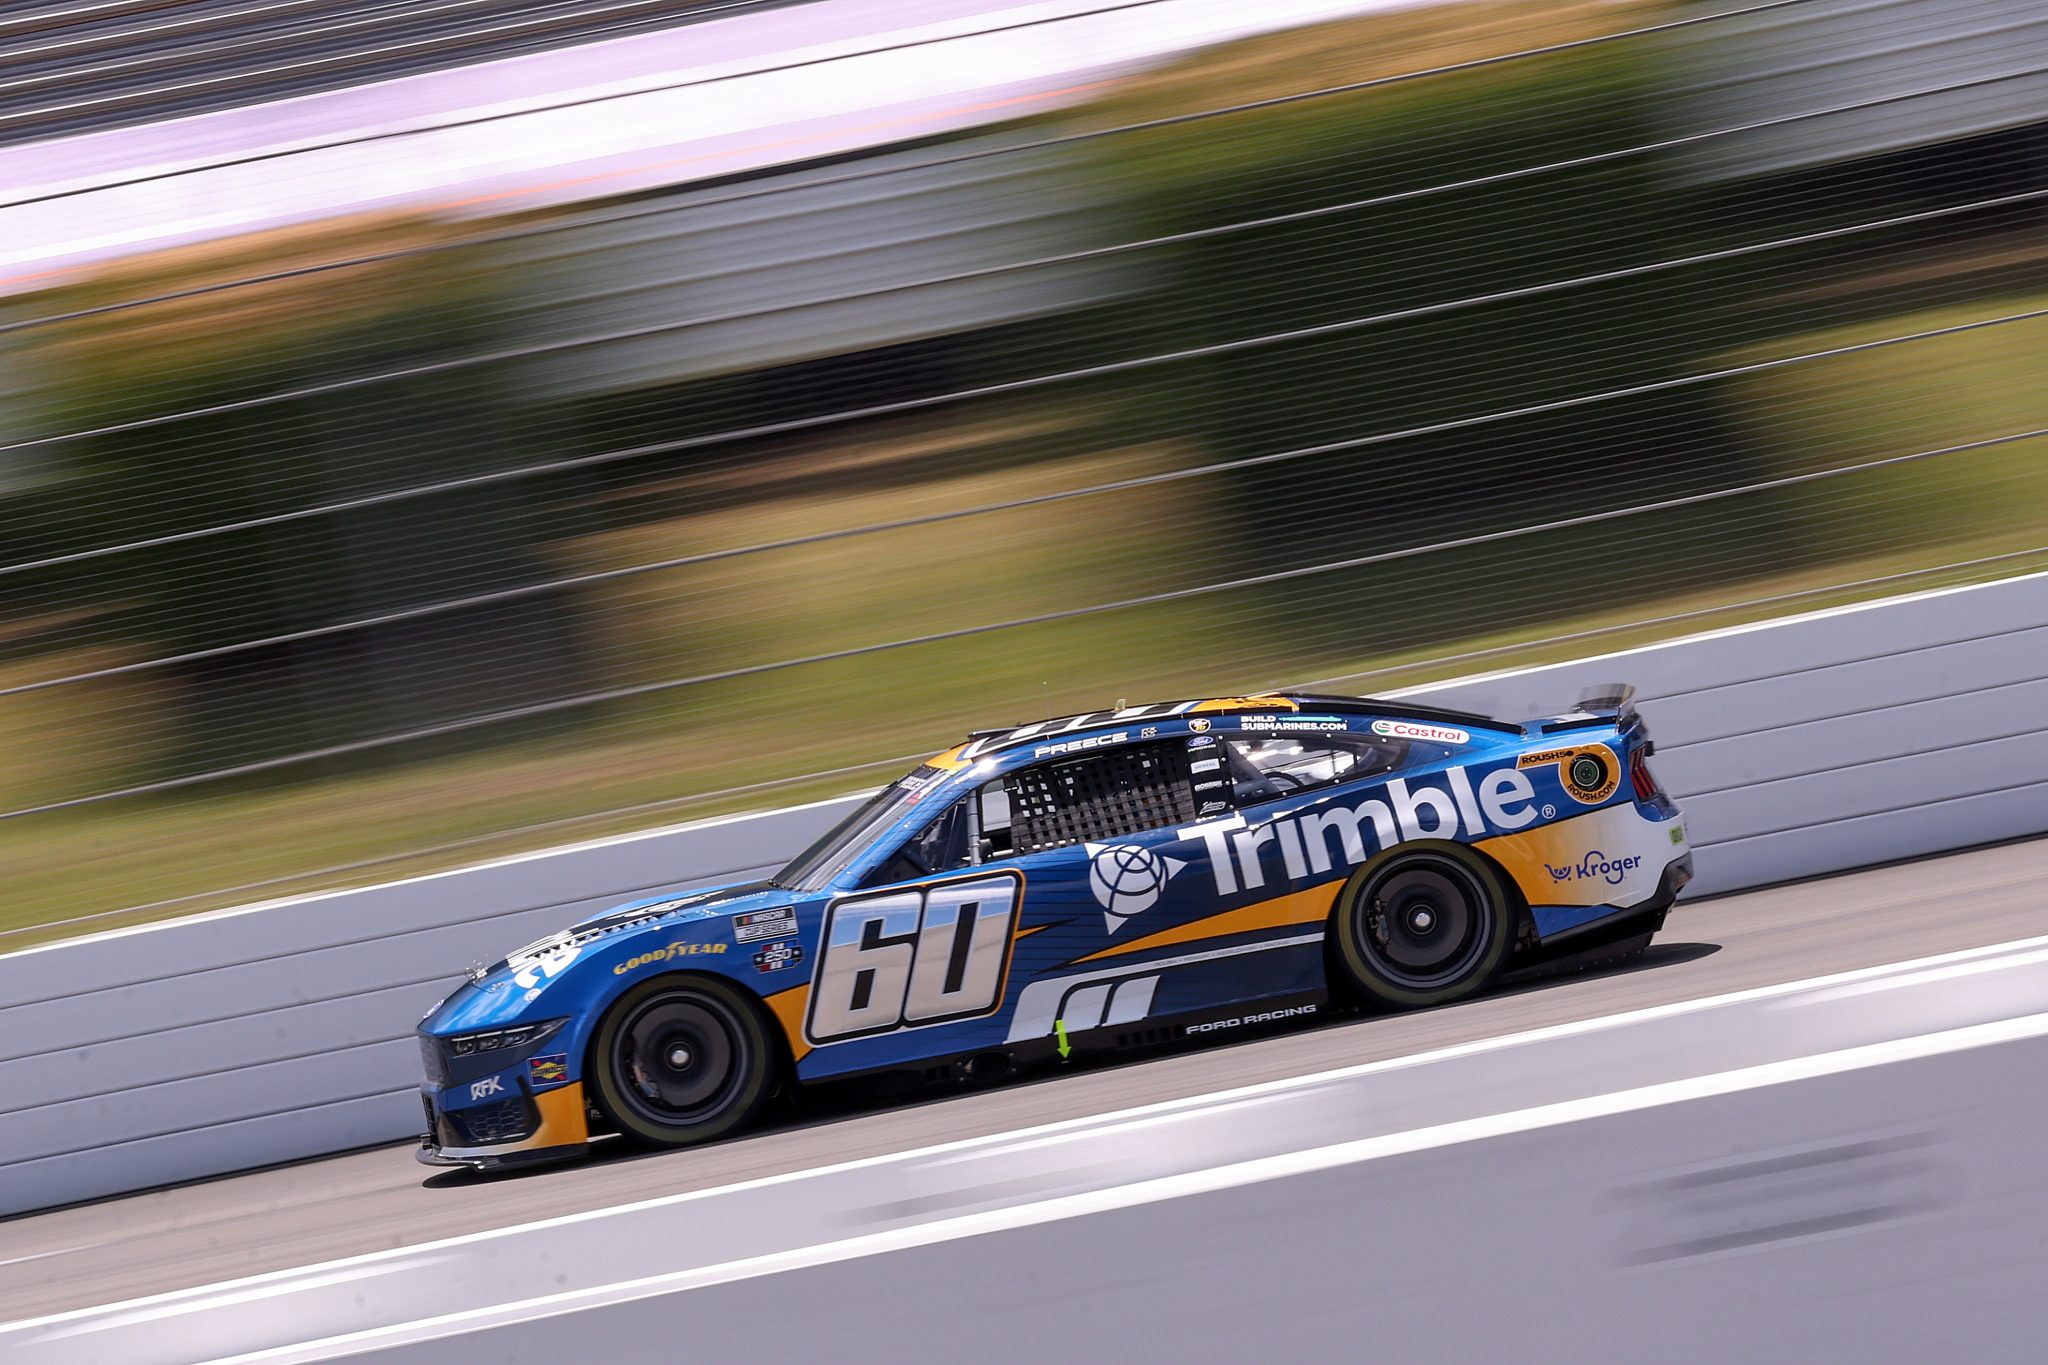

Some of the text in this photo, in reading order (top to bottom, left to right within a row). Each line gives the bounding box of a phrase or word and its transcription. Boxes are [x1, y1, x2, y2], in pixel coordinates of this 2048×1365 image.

[1241, 722, 1348, 730] SUBMARINES.COM
[1394, 725, 1461, 741] Castrol
[1034, 732, 1128, 759] PREECE
[1567, 780, 1615, 801] ROUSH.COM
[1177, 766, 1538, 896] Trimble
[1576, 850, 1641, 885] Kroger
[613, 941, 728, 975] GOODYEAR
[764, 948, 792, 963] 250
[806, 872, 1016, 1046] 60
[1185, 1004, 1317, 1035] FORD RACING
[470, 1075, 505, 1100] RFK
